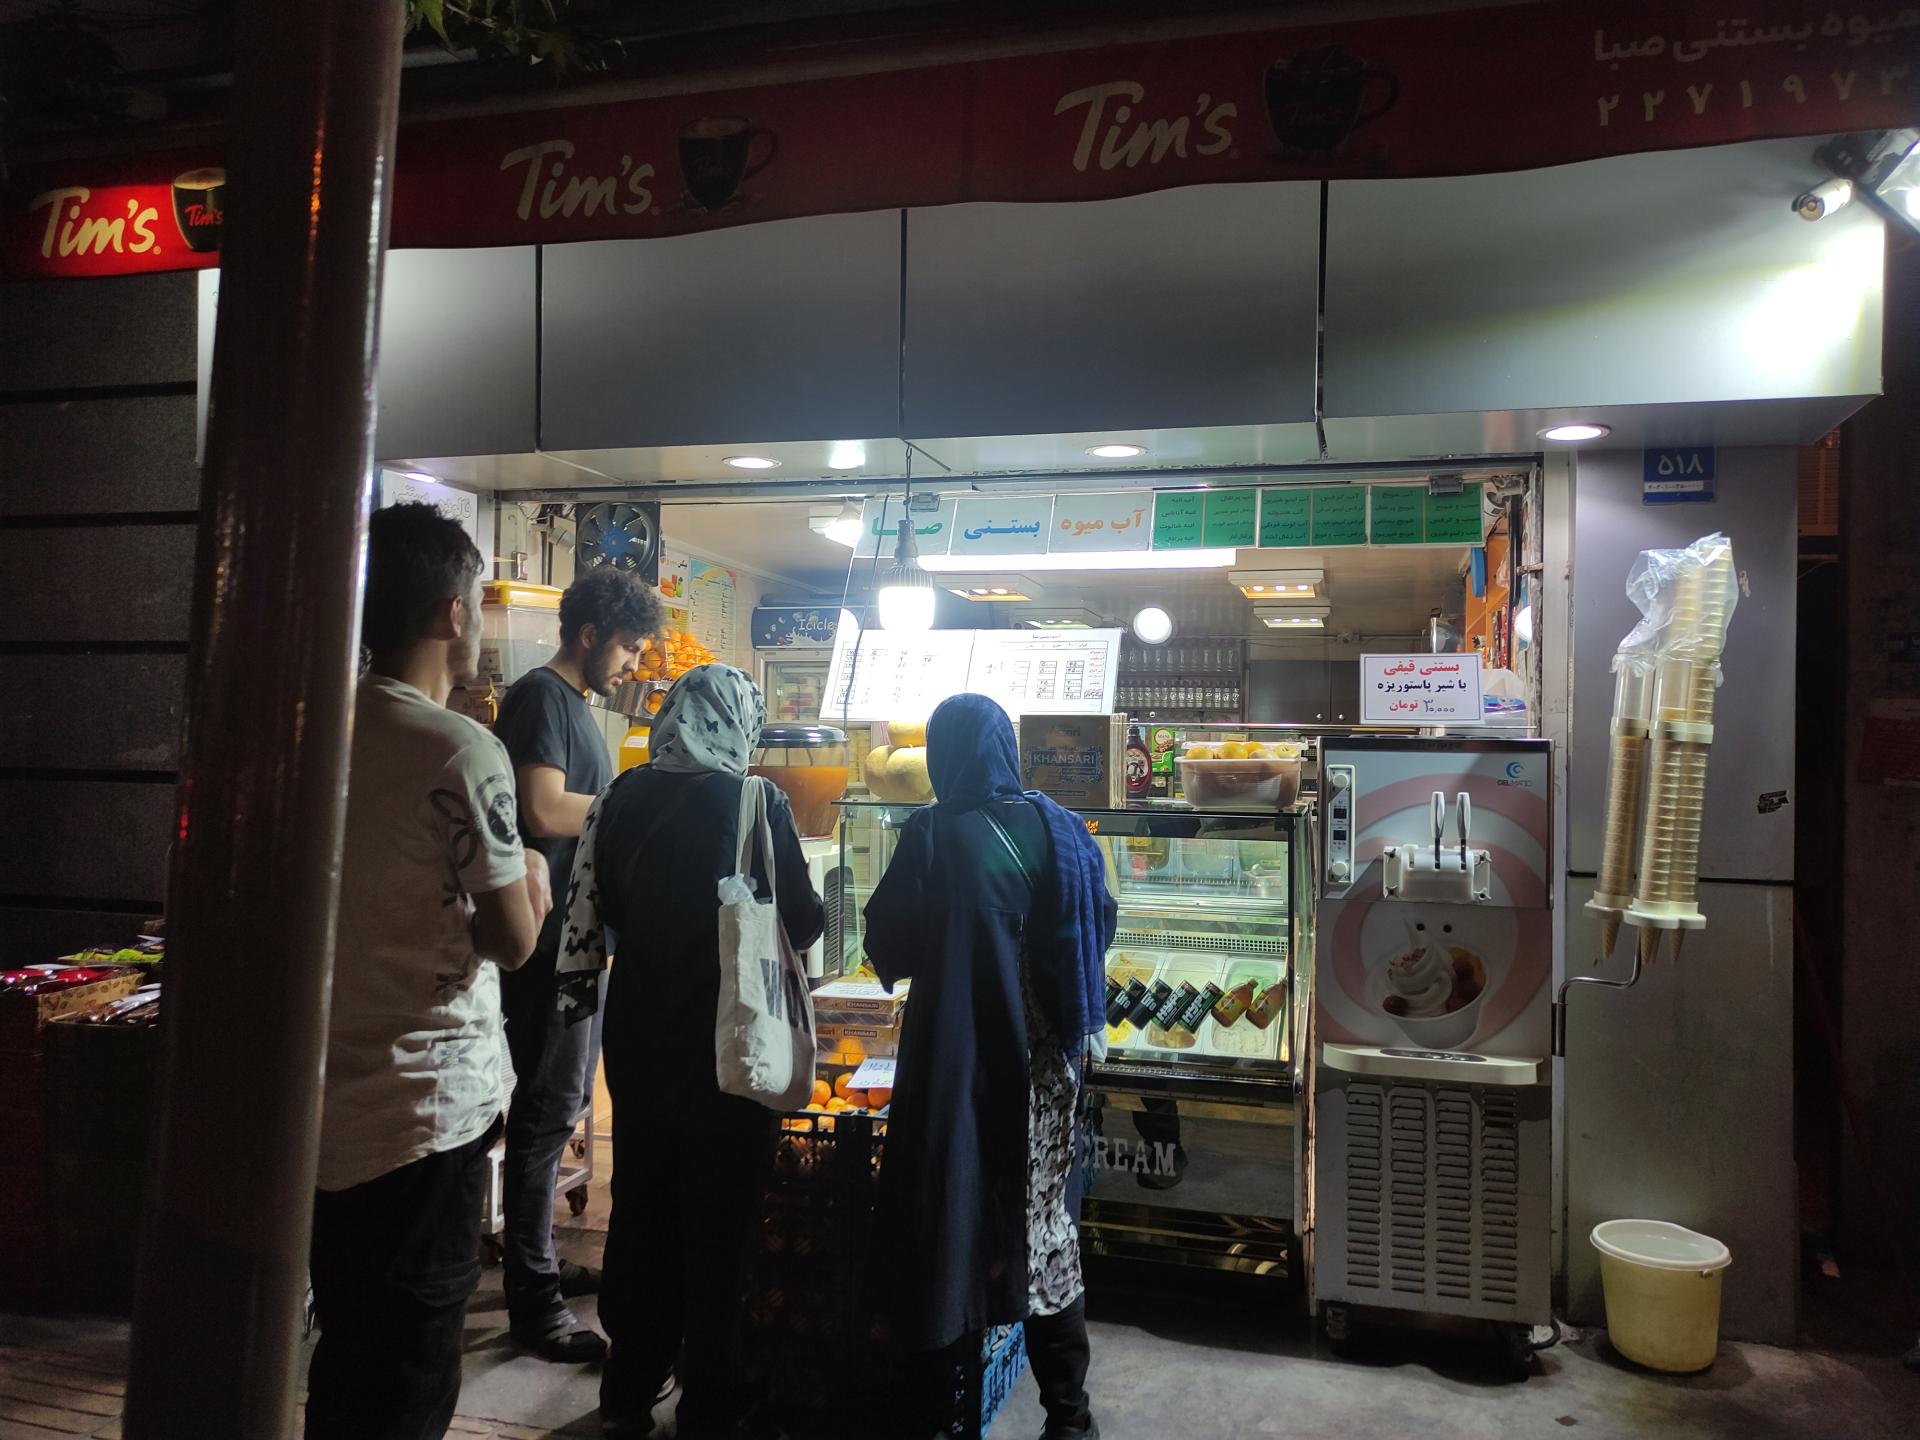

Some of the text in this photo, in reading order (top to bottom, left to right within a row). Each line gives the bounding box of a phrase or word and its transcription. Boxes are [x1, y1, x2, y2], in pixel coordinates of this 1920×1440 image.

[1594, 30, 1666, 70] صبا
[1672, 17, 1813, 62] بستنی
[1053, 80, 1239, 172] Tim's
[500, 139, 656, 221] Tim's
[30, 186, 160, 258] Tim's
[184, 204, 223, 232] Tim's
[1657, 454, 1704, 476] ۵۱۸
[963, 519, 1041, 540] بستنی
[1061, 509, 1146, 541] آب میوه
[1384, 659, 1459, 676] بستنی قیفی
[1377, 679, 1467, 693] با شیر پاستوریزه
[1389, 699, 1419, 712] تومان
[1033, 752, 1096, 765] KHANSARI
